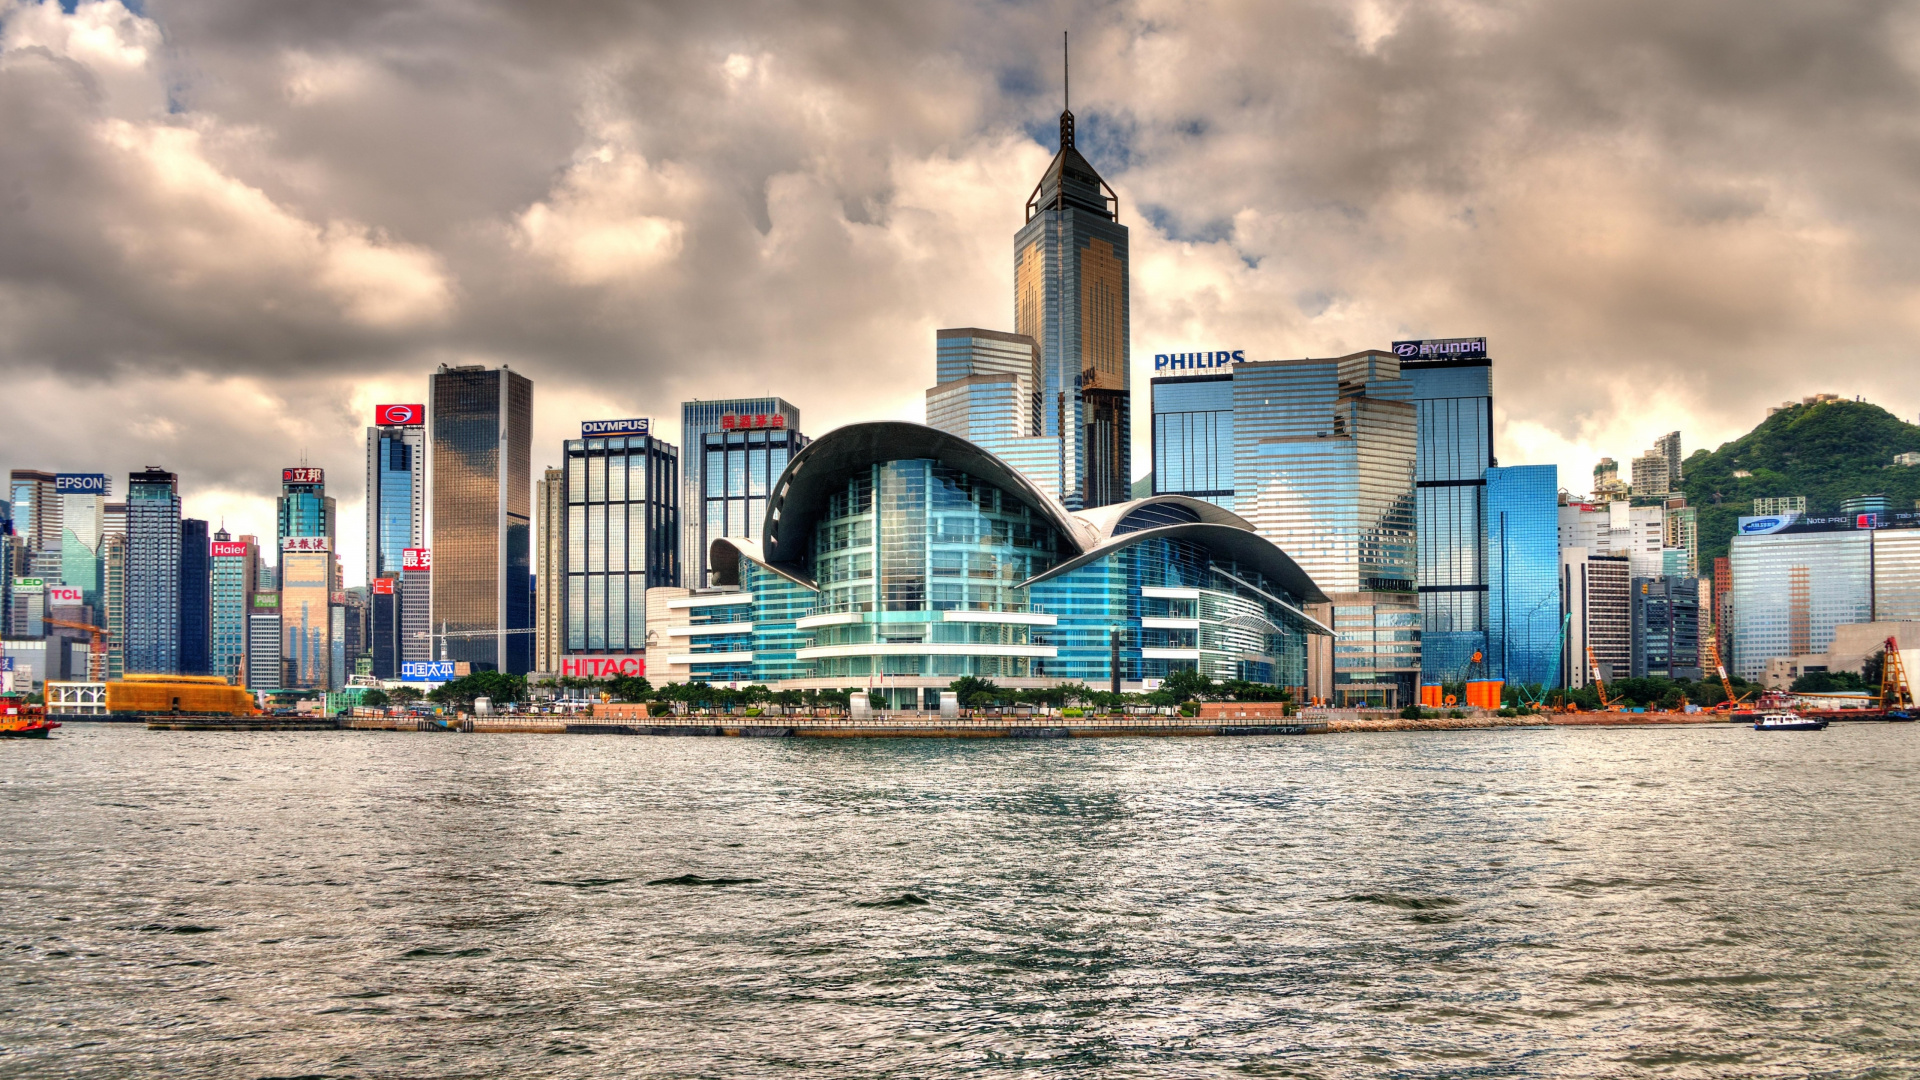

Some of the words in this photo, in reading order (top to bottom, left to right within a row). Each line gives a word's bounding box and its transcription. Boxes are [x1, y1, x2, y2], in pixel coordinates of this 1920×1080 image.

[1419, 341, 1486, 354] HYUNDAI
[1154, 350, 1245, 371] PHILIPS
[582, 419, 648, 432] OLYMPUS
[294, 468, 322, 482] 立邦
[56, 477, 103, 489] EPSON
[1806, 517, 1826, 525] Note
[215, 544, 246, 554] Haier
[13, 578, 44, 586] LED
[51, 589, 82, 600] TCL
[402, 662, 454, 677] 中国太平
